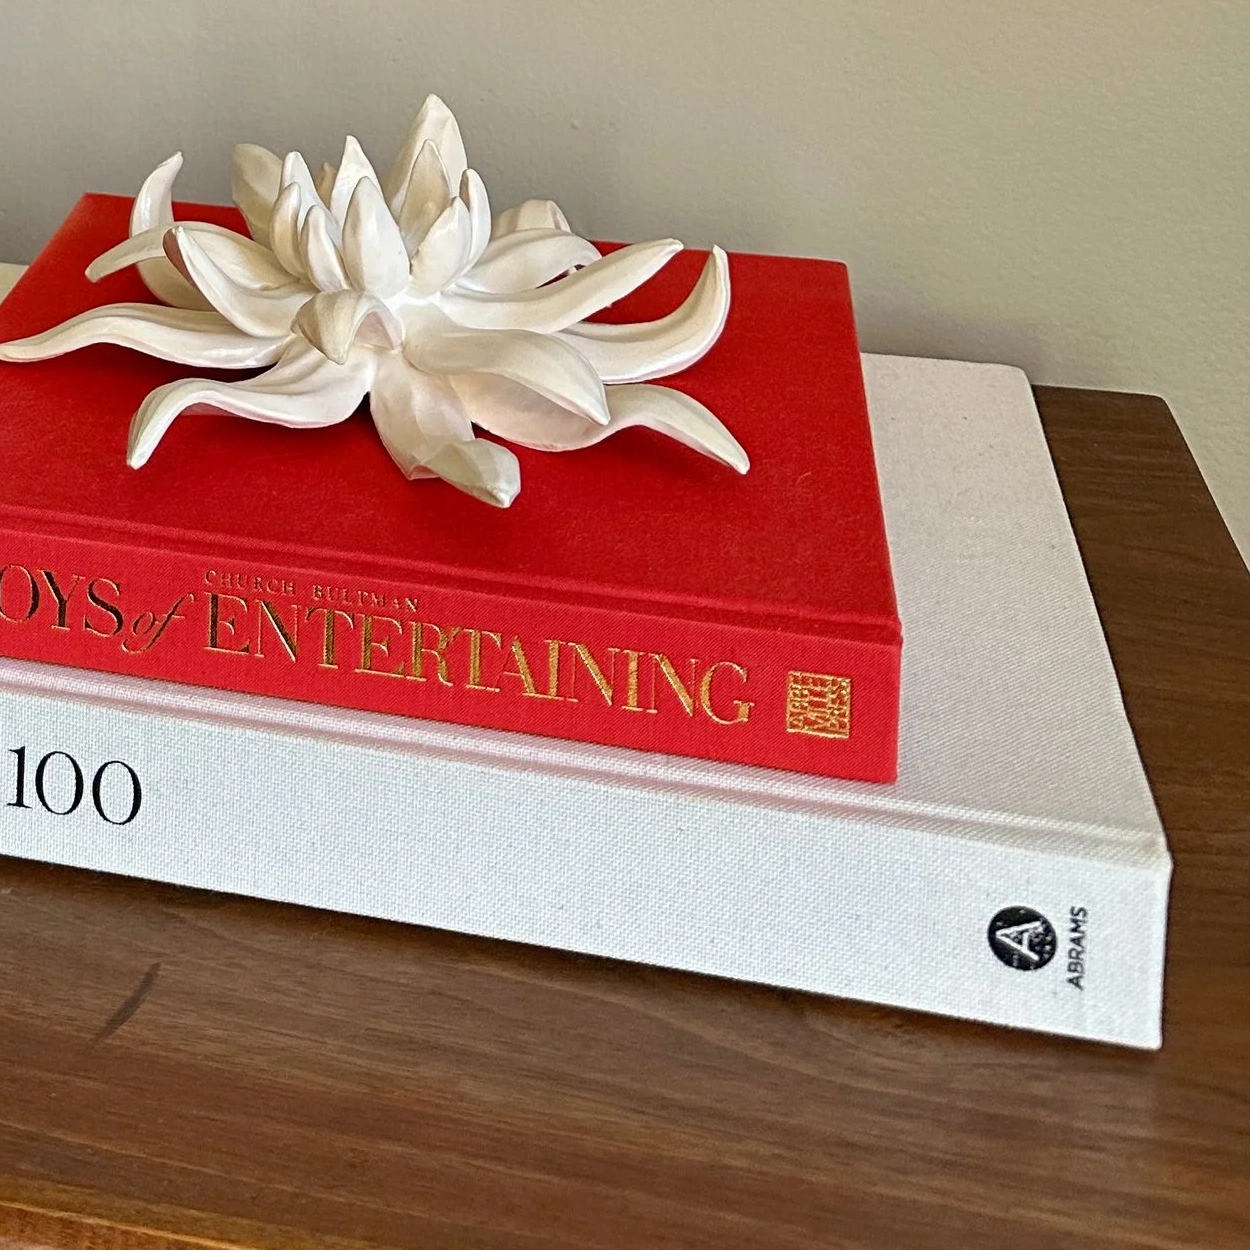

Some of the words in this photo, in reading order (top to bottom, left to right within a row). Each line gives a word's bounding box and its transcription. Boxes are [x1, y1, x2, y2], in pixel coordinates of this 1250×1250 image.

[203, 569, 297, 597] CHURCH
[311, 584, 420, 613] BULTMAN
[121, 591, 195, 655] of
[203, 591, 755, 726] ENTERTAINING
[6, 745, 144, 826] 100
[1066, 905, 1089, 991] ABRAMS
